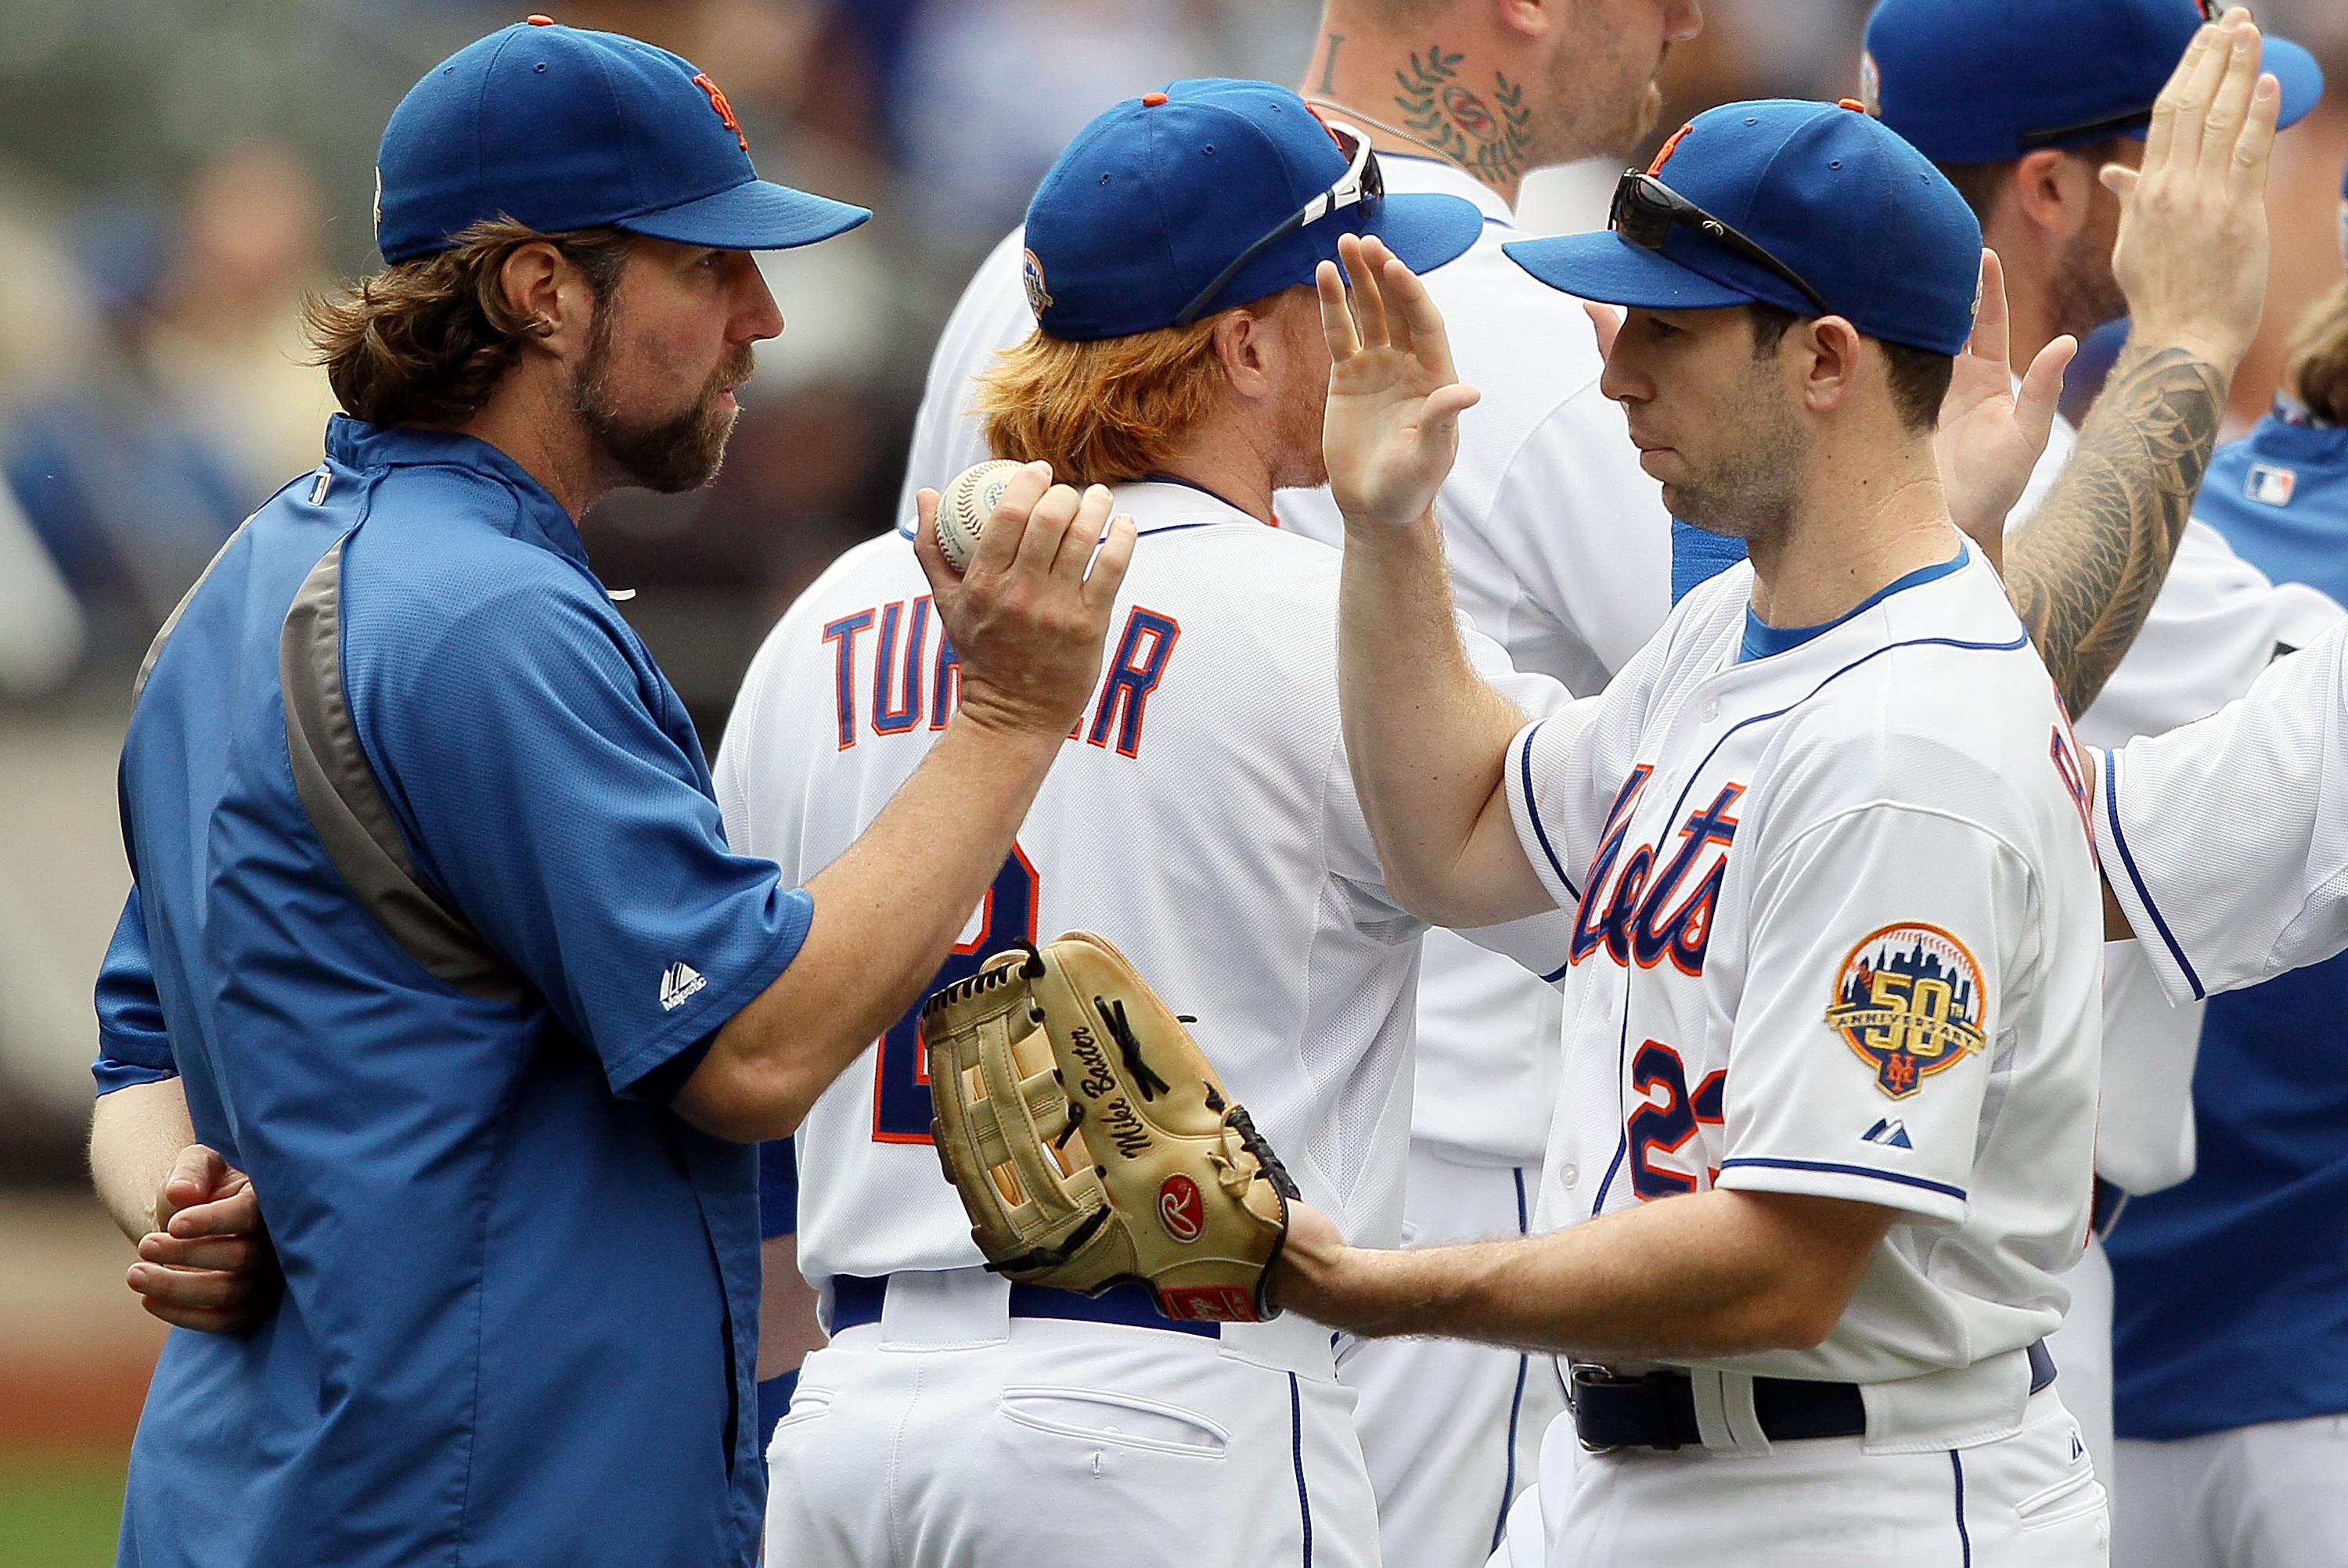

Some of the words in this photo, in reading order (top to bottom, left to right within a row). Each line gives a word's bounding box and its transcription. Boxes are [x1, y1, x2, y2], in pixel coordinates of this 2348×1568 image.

[821, 593, 1183, 760] TUR
[1070, 1026, 1118, 1099] Baxter
[1837, 1012, 1973, 1047] ANNIVERSARY
[1100, 1097, 1153, 1160] Mike
